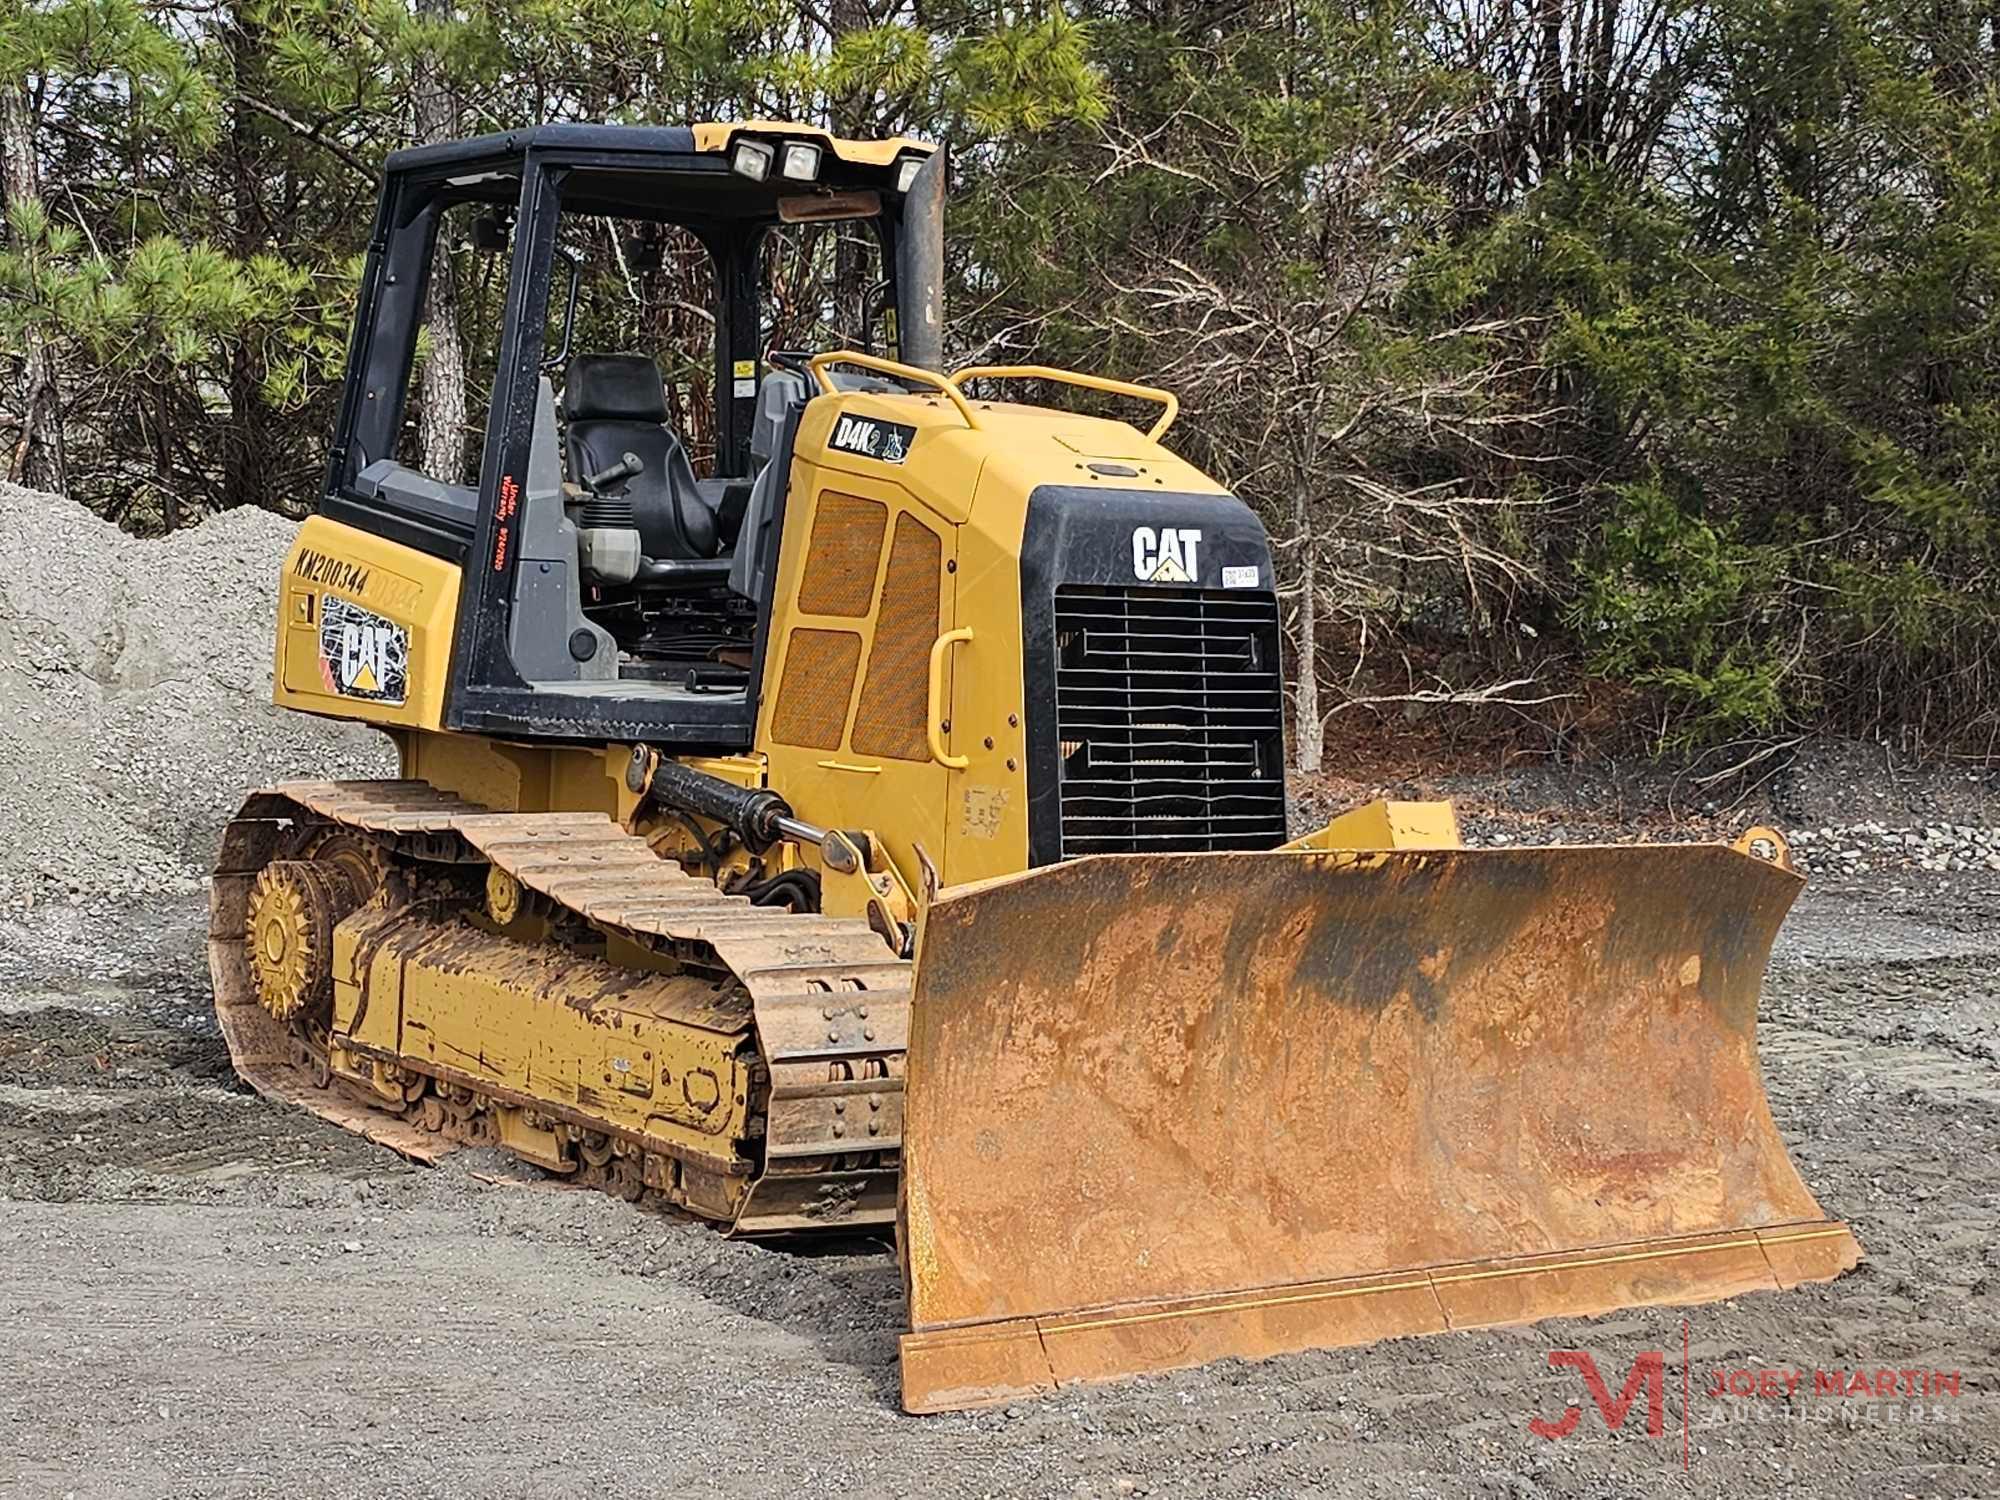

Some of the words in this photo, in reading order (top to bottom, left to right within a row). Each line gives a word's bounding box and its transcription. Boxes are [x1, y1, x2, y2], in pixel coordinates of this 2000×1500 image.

[495, 475, 512, 522] Warranty
[508, 484, 519, 516] Under
[293, 547, 371, 597] KM200344
[1132, 526, 1202, 582] CAT
[341, 621, 392, 693] CAT
